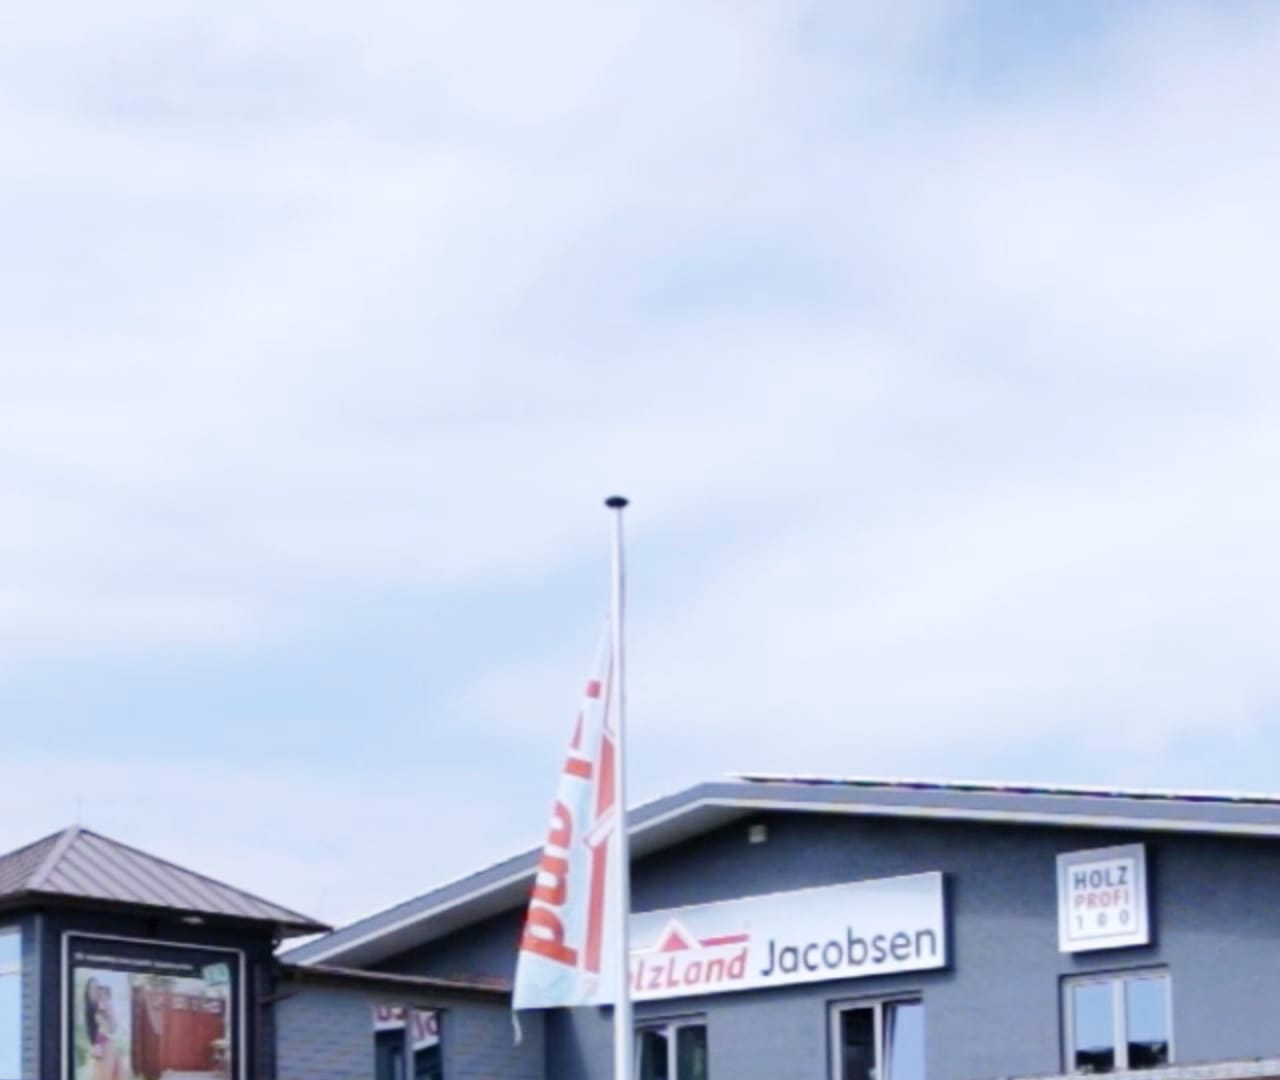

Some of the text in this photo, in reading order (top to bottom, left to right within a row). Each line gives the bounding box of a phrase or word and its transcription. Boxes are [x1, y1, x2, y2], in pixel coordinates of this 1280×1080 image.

[1074, 866, 1128, 890] HOLZ
[1074, 888, 1129, 911] PROFI
[627, 926, 937, 992] lzLand Jacobsen
